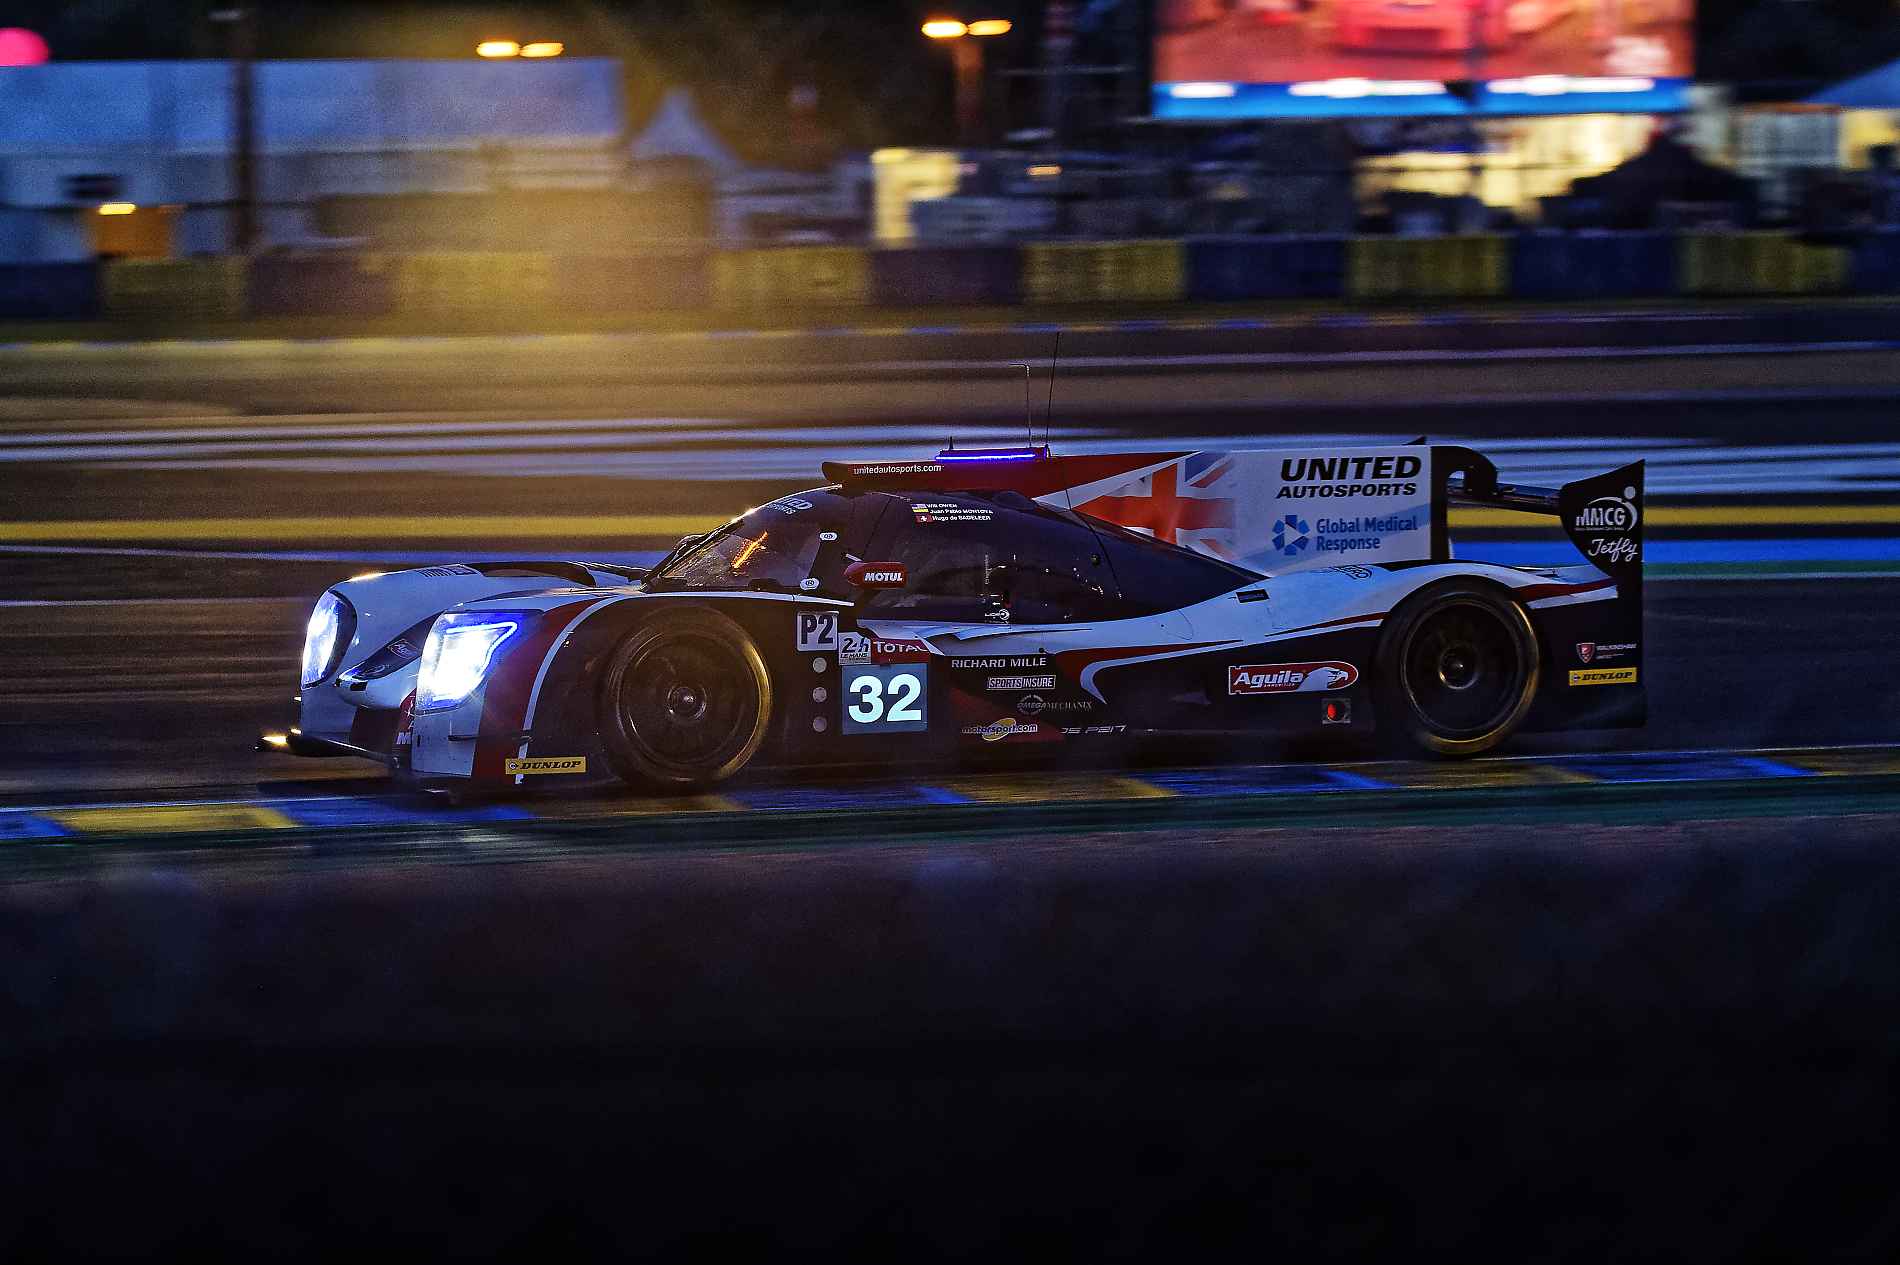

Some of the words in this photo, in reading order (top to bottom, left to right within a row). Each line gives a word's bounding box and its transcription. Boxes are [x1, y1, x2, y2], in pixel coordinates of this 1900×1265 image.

[852, 464, 942, 475] unitedautosports.com
[1281, 456, 1421, 482] UNITED
[1276, 483, 1417, 499] AUTOSPORTS
[1316, 519, 1360, 534] Global
[1364, 516, 1418, 532] Medical
[1316, 536, 1381, 553] Response
[1587, 537, 1638, 563] Jetfly
[864, 572, 903, 582] MOTUL
[800, 614, 834, 645] P2
[873, 640, 927, 654] TOTAL
[951, 659, 1006, 668] RICHARD
[1010, 657, 1047, 667] MILLE
[1233, 670, 1304, 689] Aguila
[1582, 672, 1632, 680] DUNLOP
[848, 673, 922, 724] 32
[961, 724, 1038, 735] motorsport.com
[519, 761, 581, 769] DUNLOP
